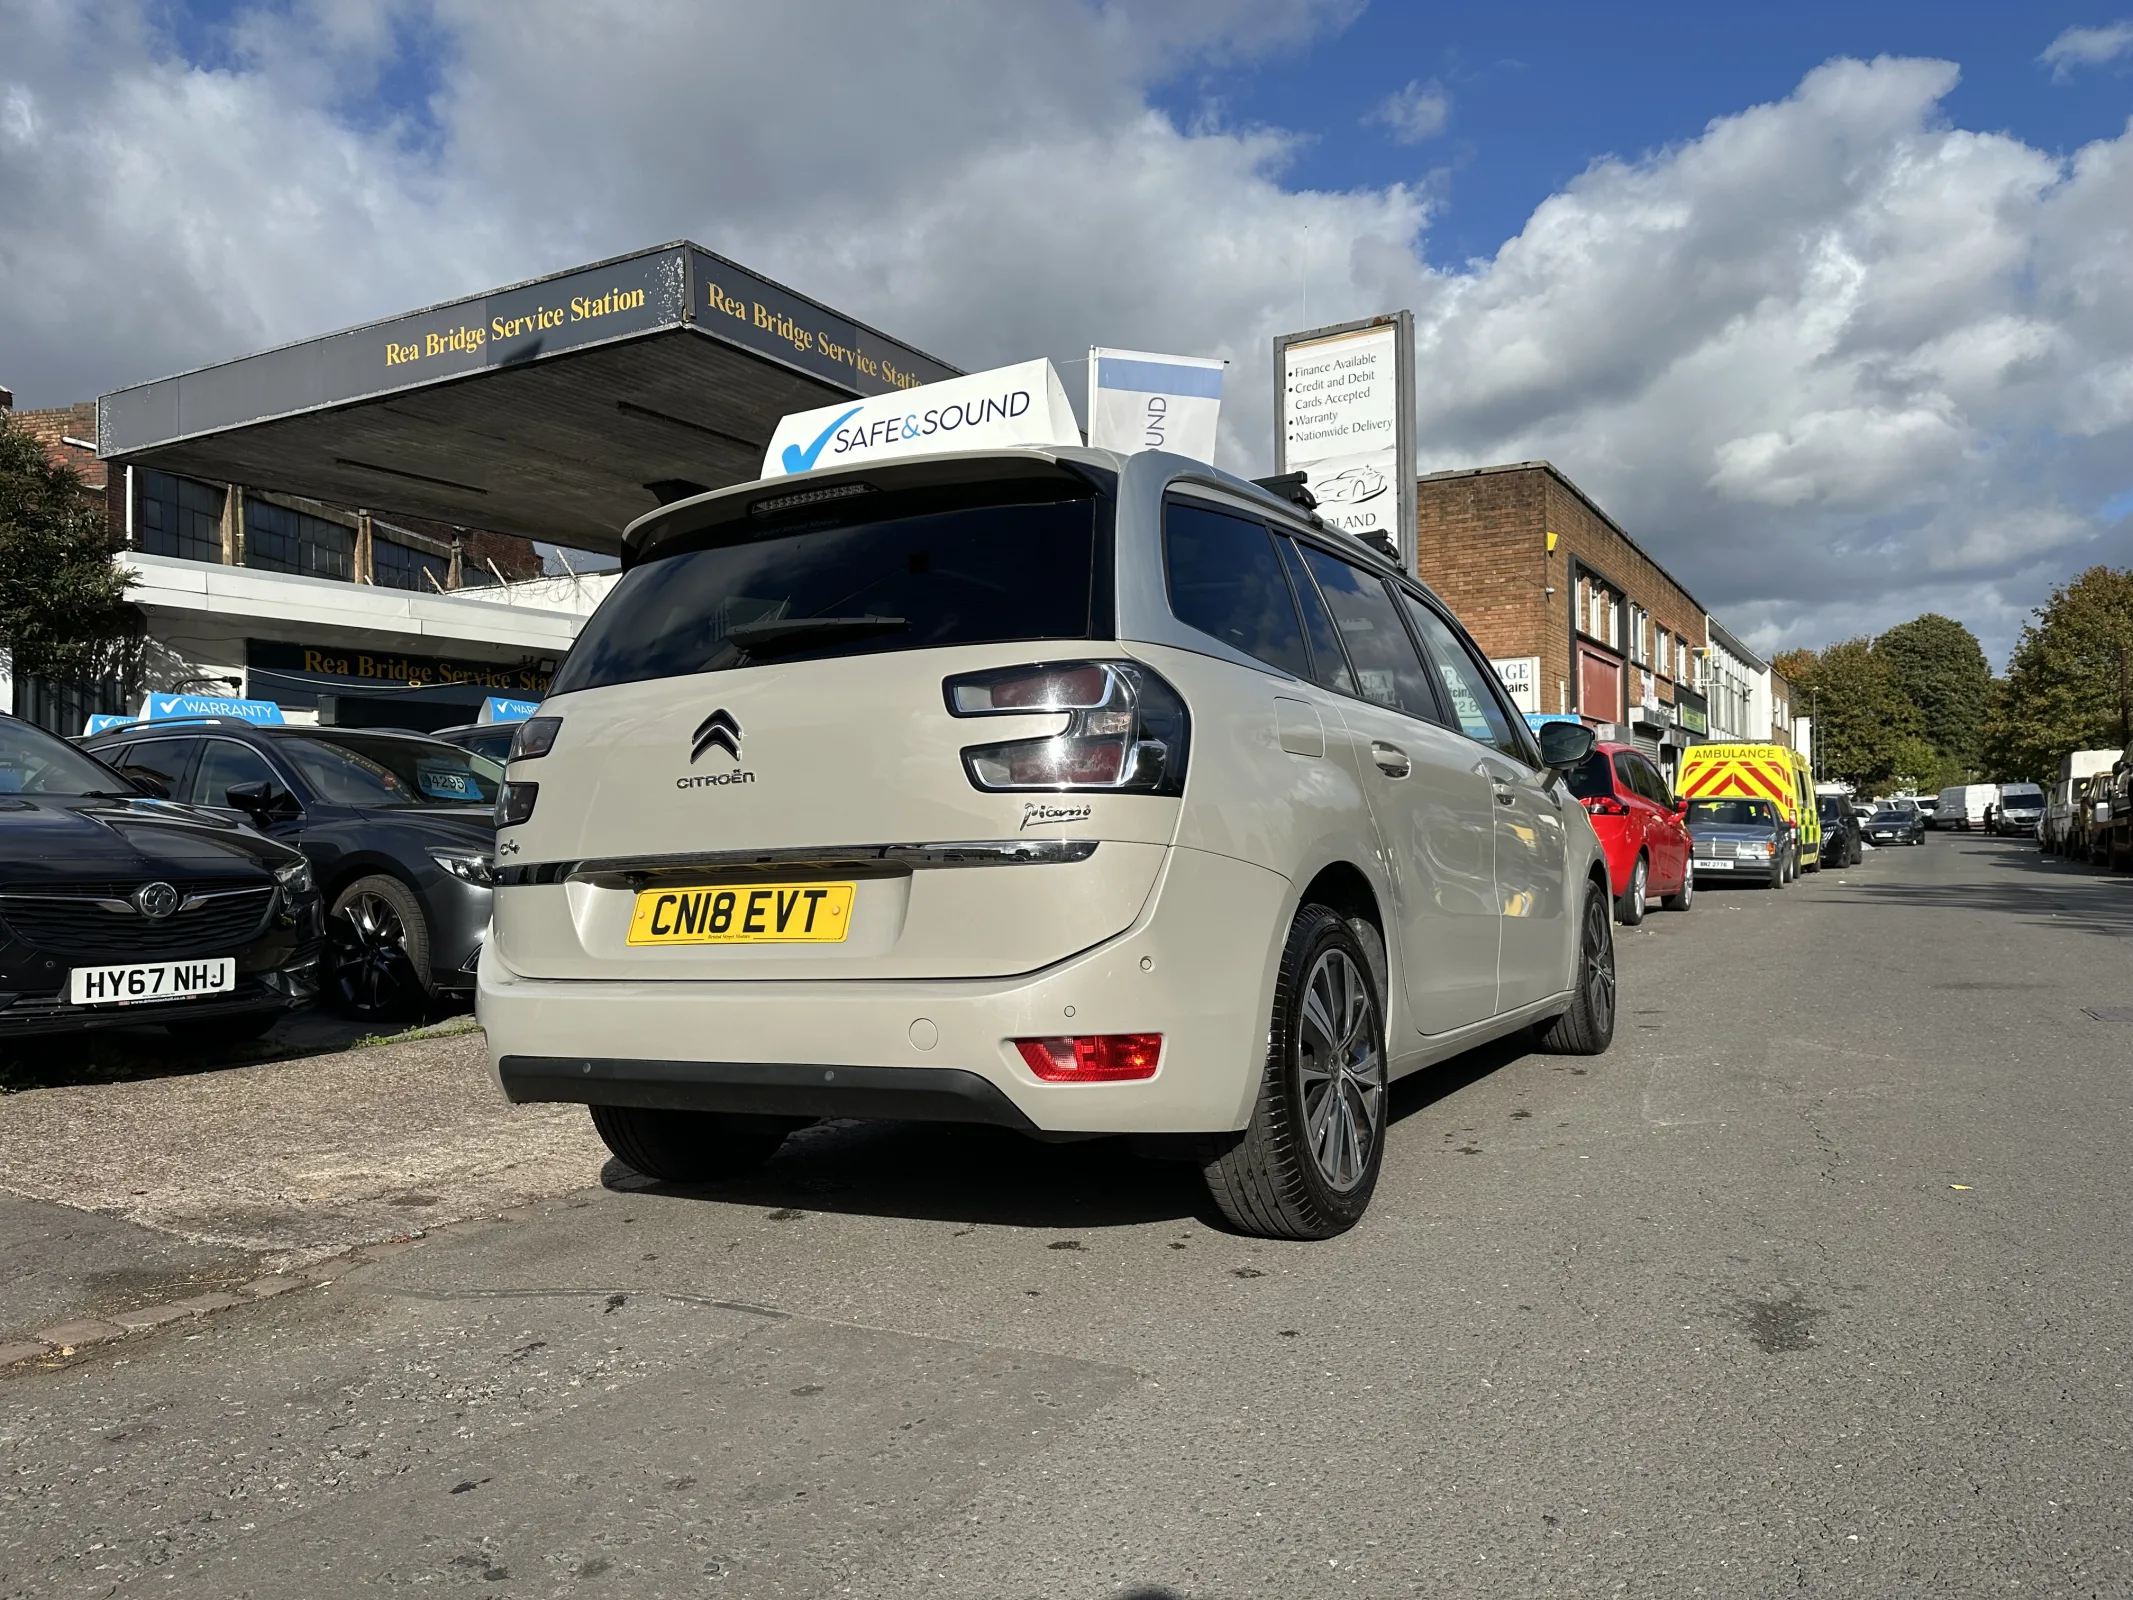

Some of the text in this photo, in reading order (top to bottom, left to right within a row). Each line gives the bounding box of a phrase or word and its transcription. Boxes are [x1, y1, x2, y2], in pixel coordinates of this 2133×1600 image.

[385, 284, 645, 367] Rea Bridge Service Station
[707, 282, 746, 322] Rea
[752, 301, 813, 351] Bridge
[817, 331, 877, 377] Service
[1295, 353, 1377, 377] Finance Available
[1295, 371, 1375, 393] Credit and Debit
[1295, 387, 1370, 410] Cards Accepted
[1145, 396, 1166, 451] UND
[1295, 411, 1338, 425] Warranty
[1295, 419, 1393, 442] Nationwide Delivery
[304, 650, 349, 675] Rea
[358, 656, 433, 687] Bridge
[439, 663, 510, 689] Service
[1505, 682, 1529, 693] airs
[183, 700, 272, 718] WARRANTY
[1694, 749, 1775, 759] AMBULANCE
[651, 890, 828, 934] CN18 EVT
[86, 963, 224, 998] HY67 NHJ
